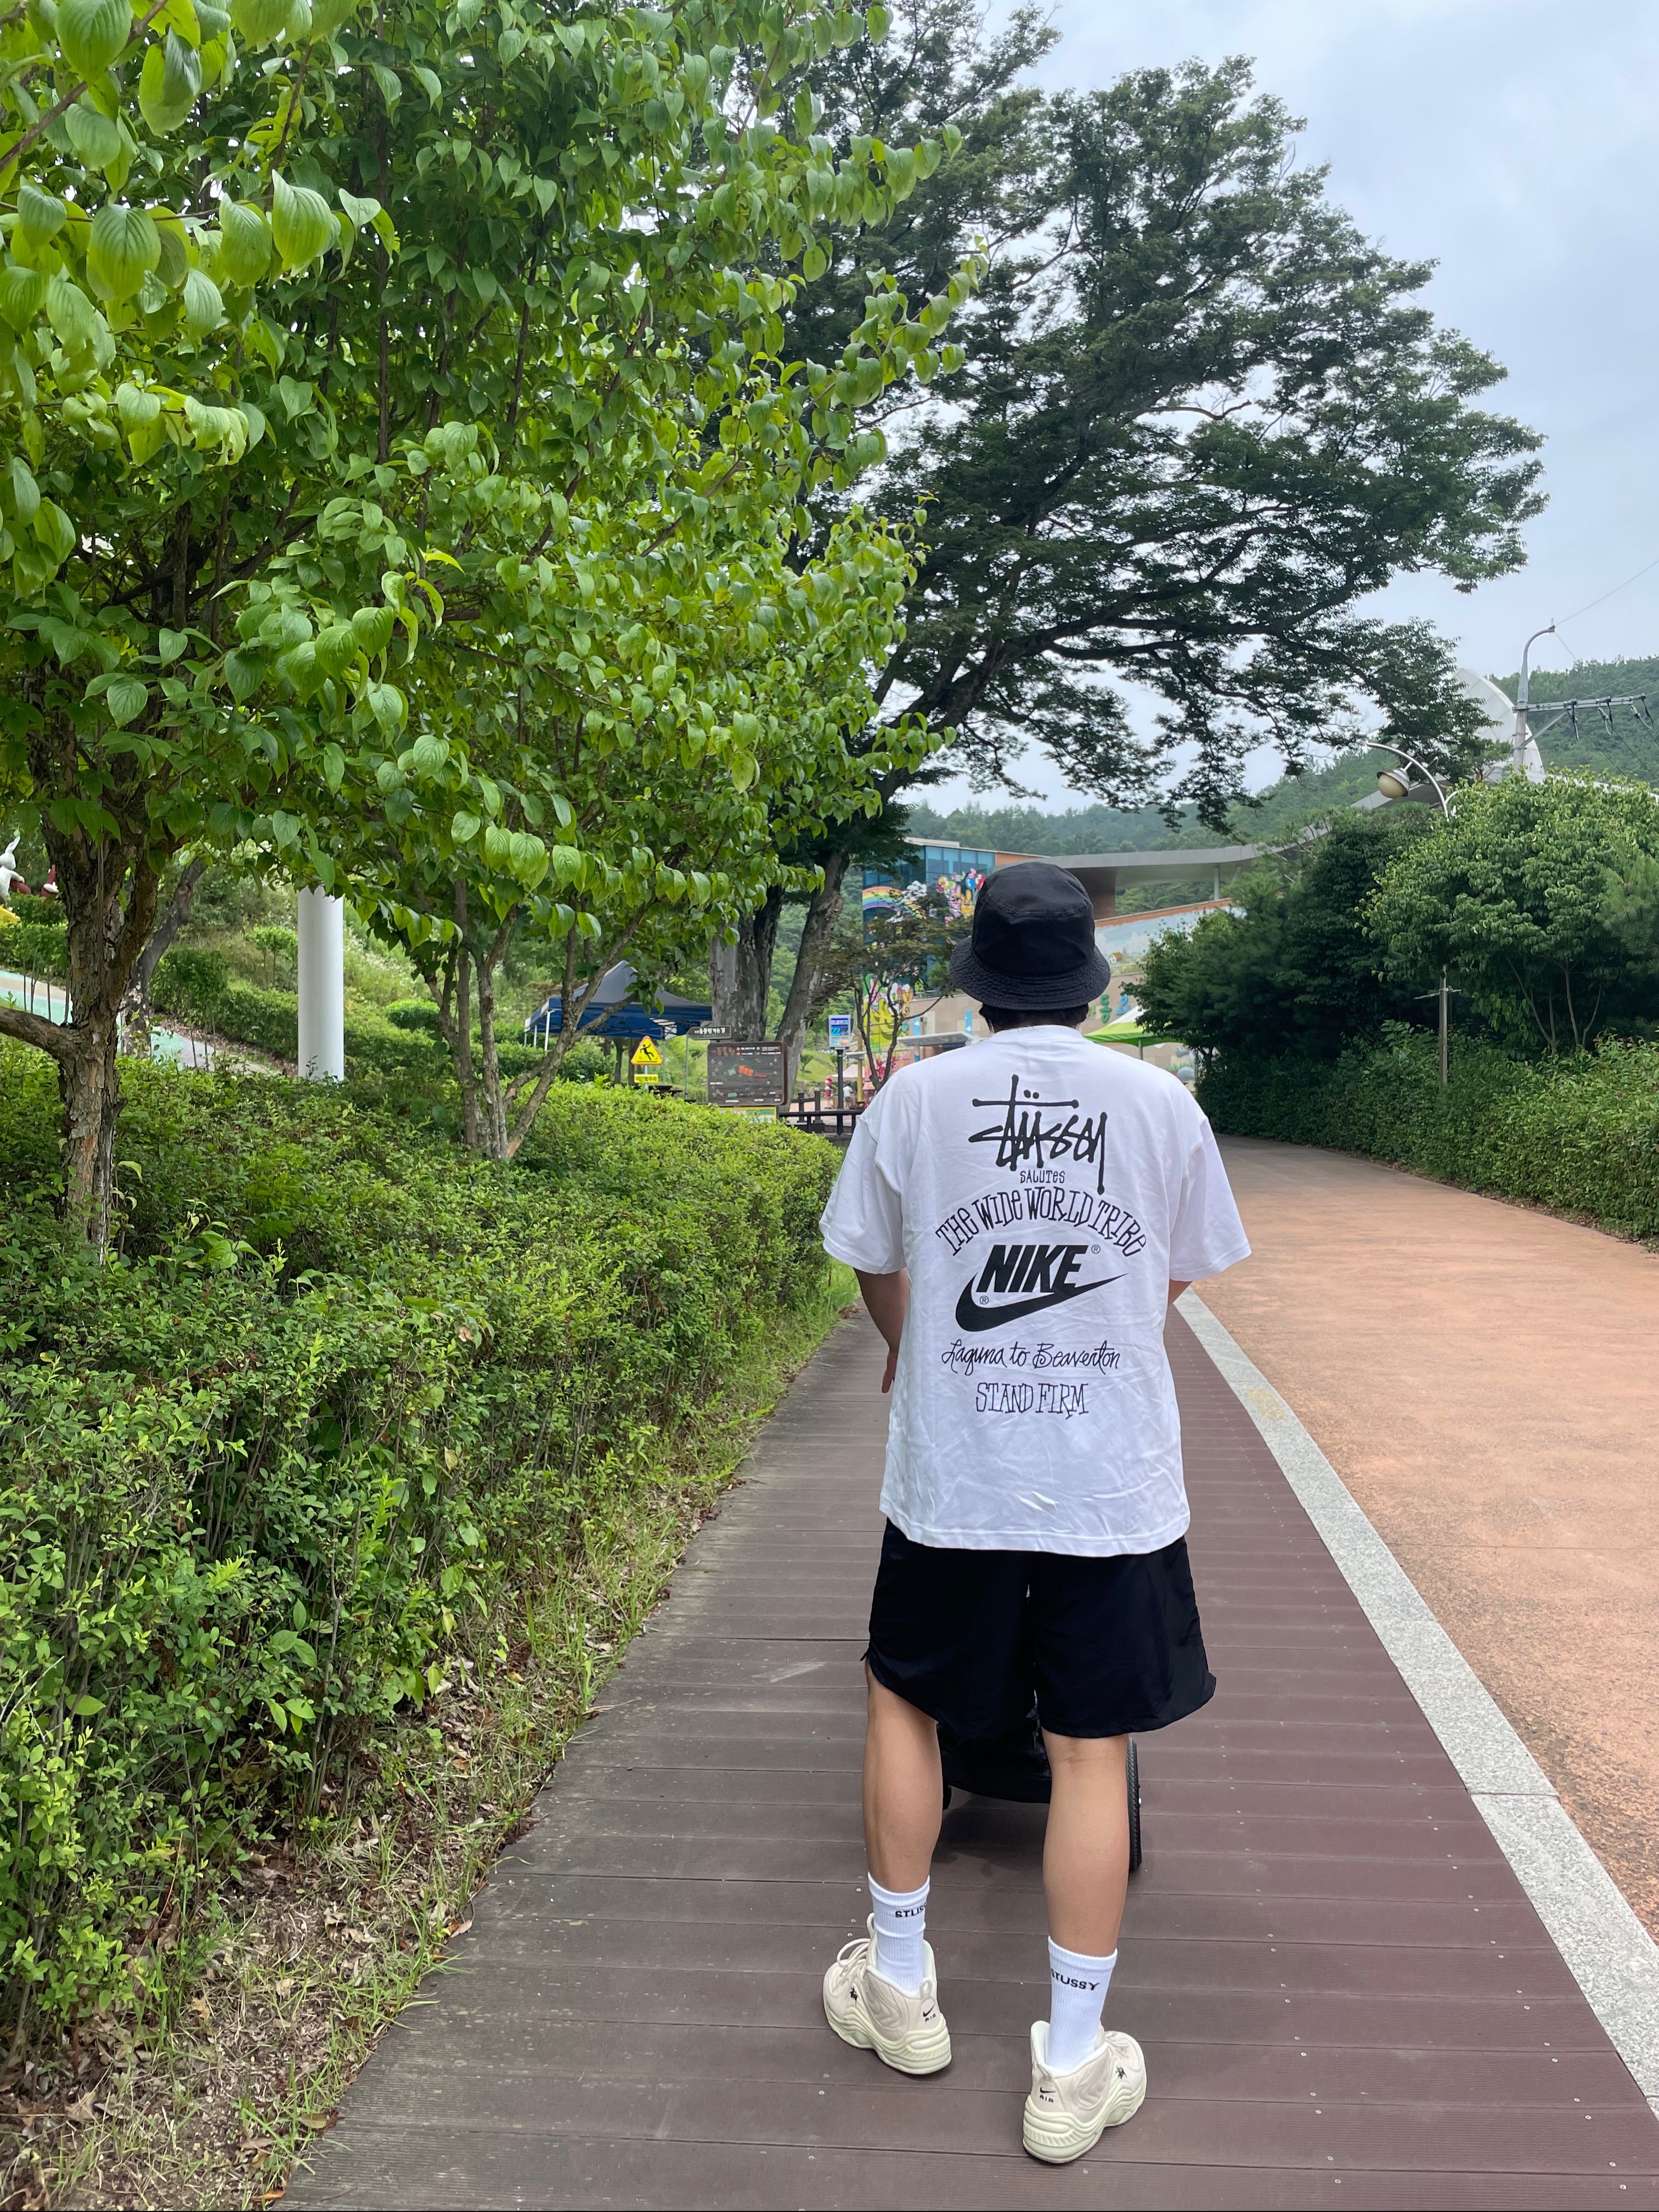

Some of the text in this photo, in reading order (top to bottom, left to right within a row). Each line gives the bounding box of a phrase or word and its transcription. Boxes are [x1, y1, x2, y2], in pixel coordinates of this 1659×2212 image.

[1024, 1186, 1093, 1228] WORLD
[975, 1244, 1090, 1293] NIKE
[941, 1339, 1121, 1376] Laguna to Beaverton
[975, 1382, 1089, 1420] STAND FIRM
[1051, 1968, 1100, 1991] STUSSY
[1039, 2094, 1054, 2103] AIR
